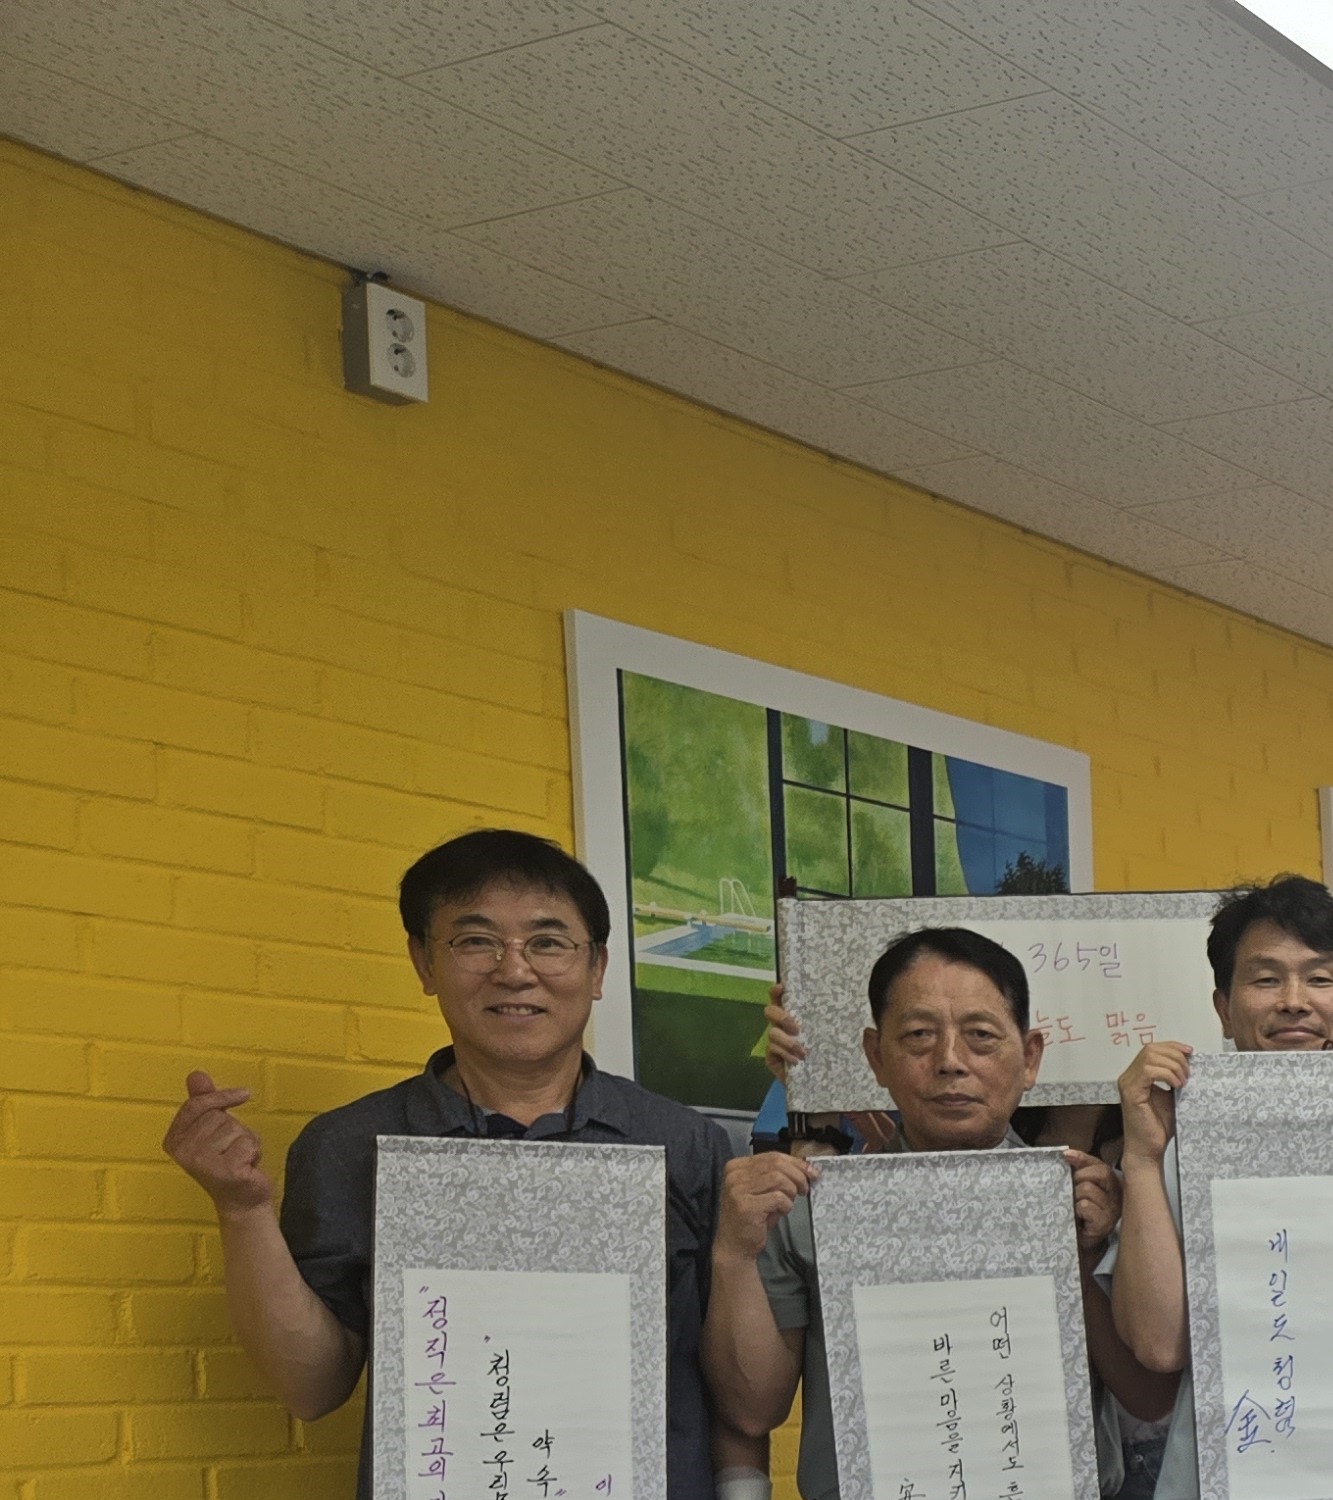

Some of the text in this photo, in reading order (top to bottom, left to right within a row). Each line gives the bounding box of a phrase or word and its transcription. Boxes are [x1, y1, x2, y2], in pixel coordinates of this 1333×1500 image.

[1028, 941, 1123, 979] 365일
[1029, 1009, 1157, 1047] 늘도 맑음
[930, 1332, 957, 1384] 바른
[989, 1306, 1012, 1360] 어떤
[1267, 1228, 1297, 1441] 내일도 청렴
[936, 1387, 964, 1454] 마음을
[994, 1373, 1025, 1471] 상황에서도
